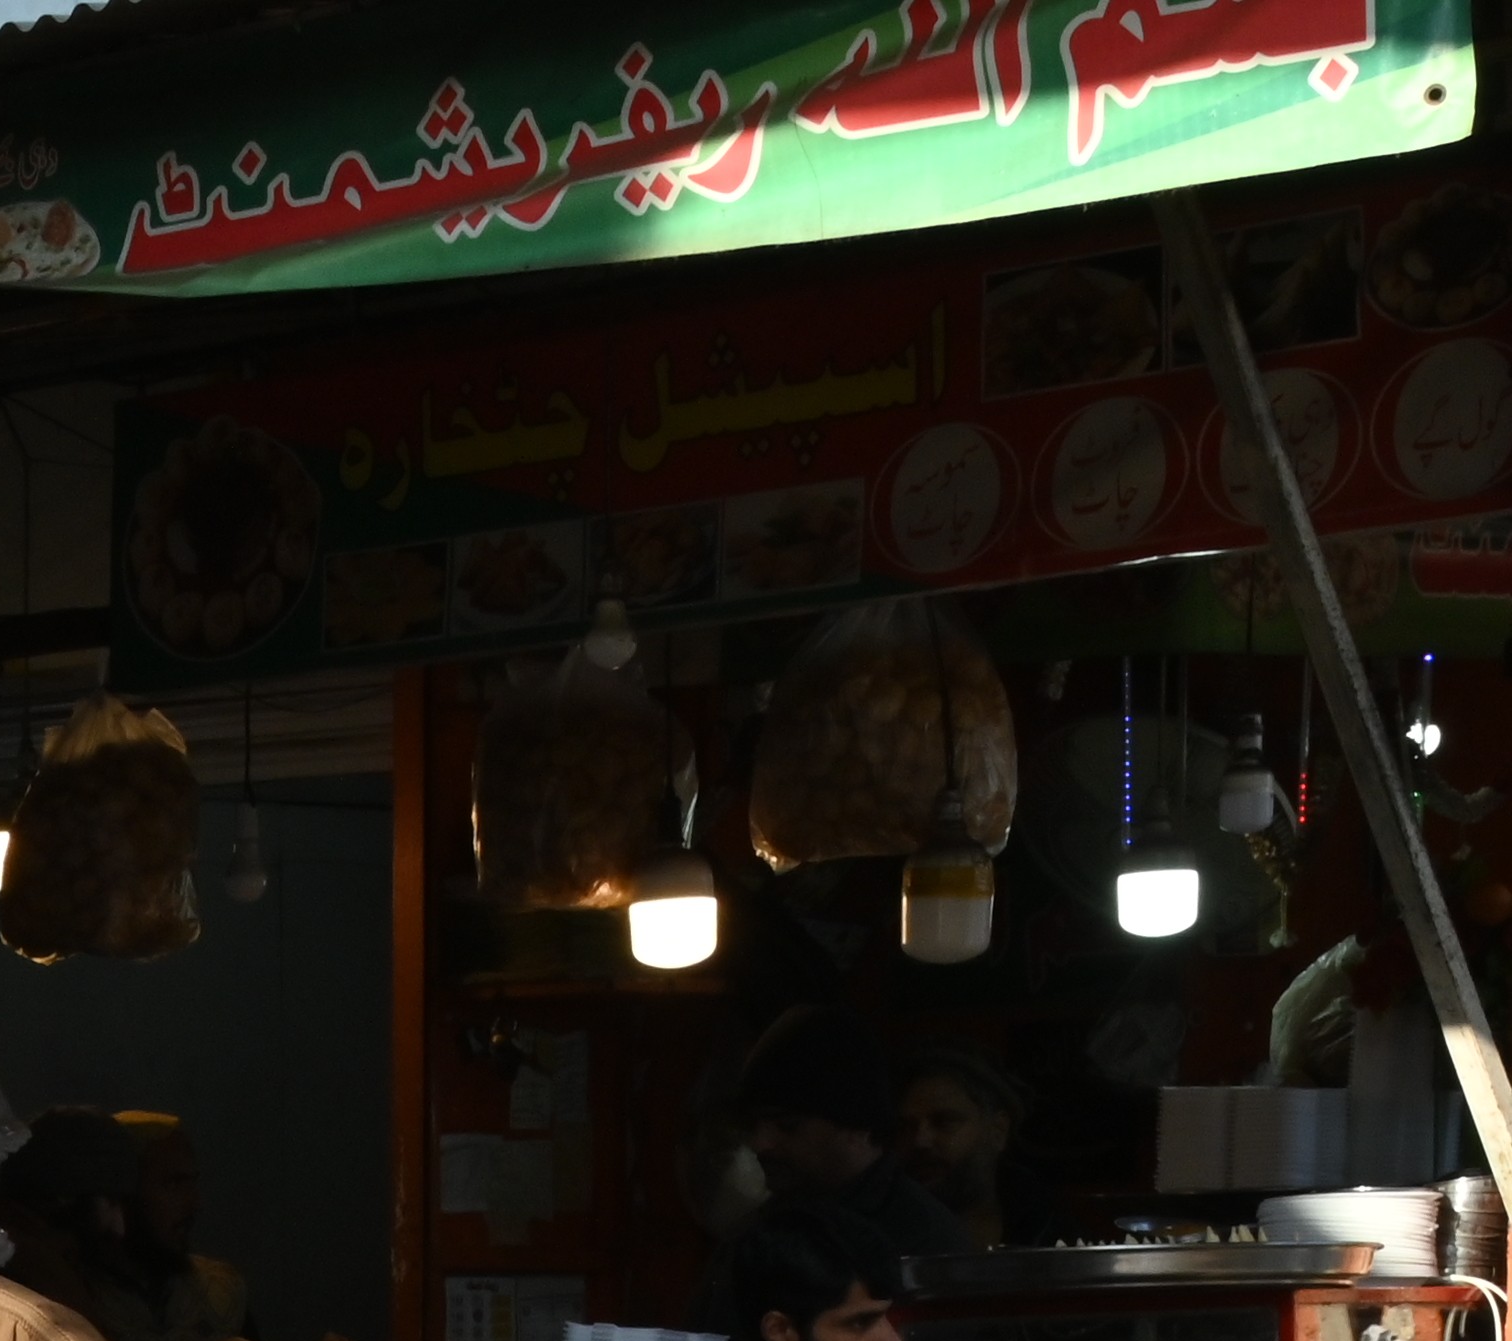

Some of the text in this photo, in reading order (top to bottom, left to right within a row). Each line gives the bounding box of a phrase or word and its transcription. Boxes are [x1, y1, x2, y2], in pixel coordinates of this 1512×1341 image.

[118, 38, 779, 276] ریفریشمنٹ
[339, 299, 952, 511] اسپیشل چٹخارہ
